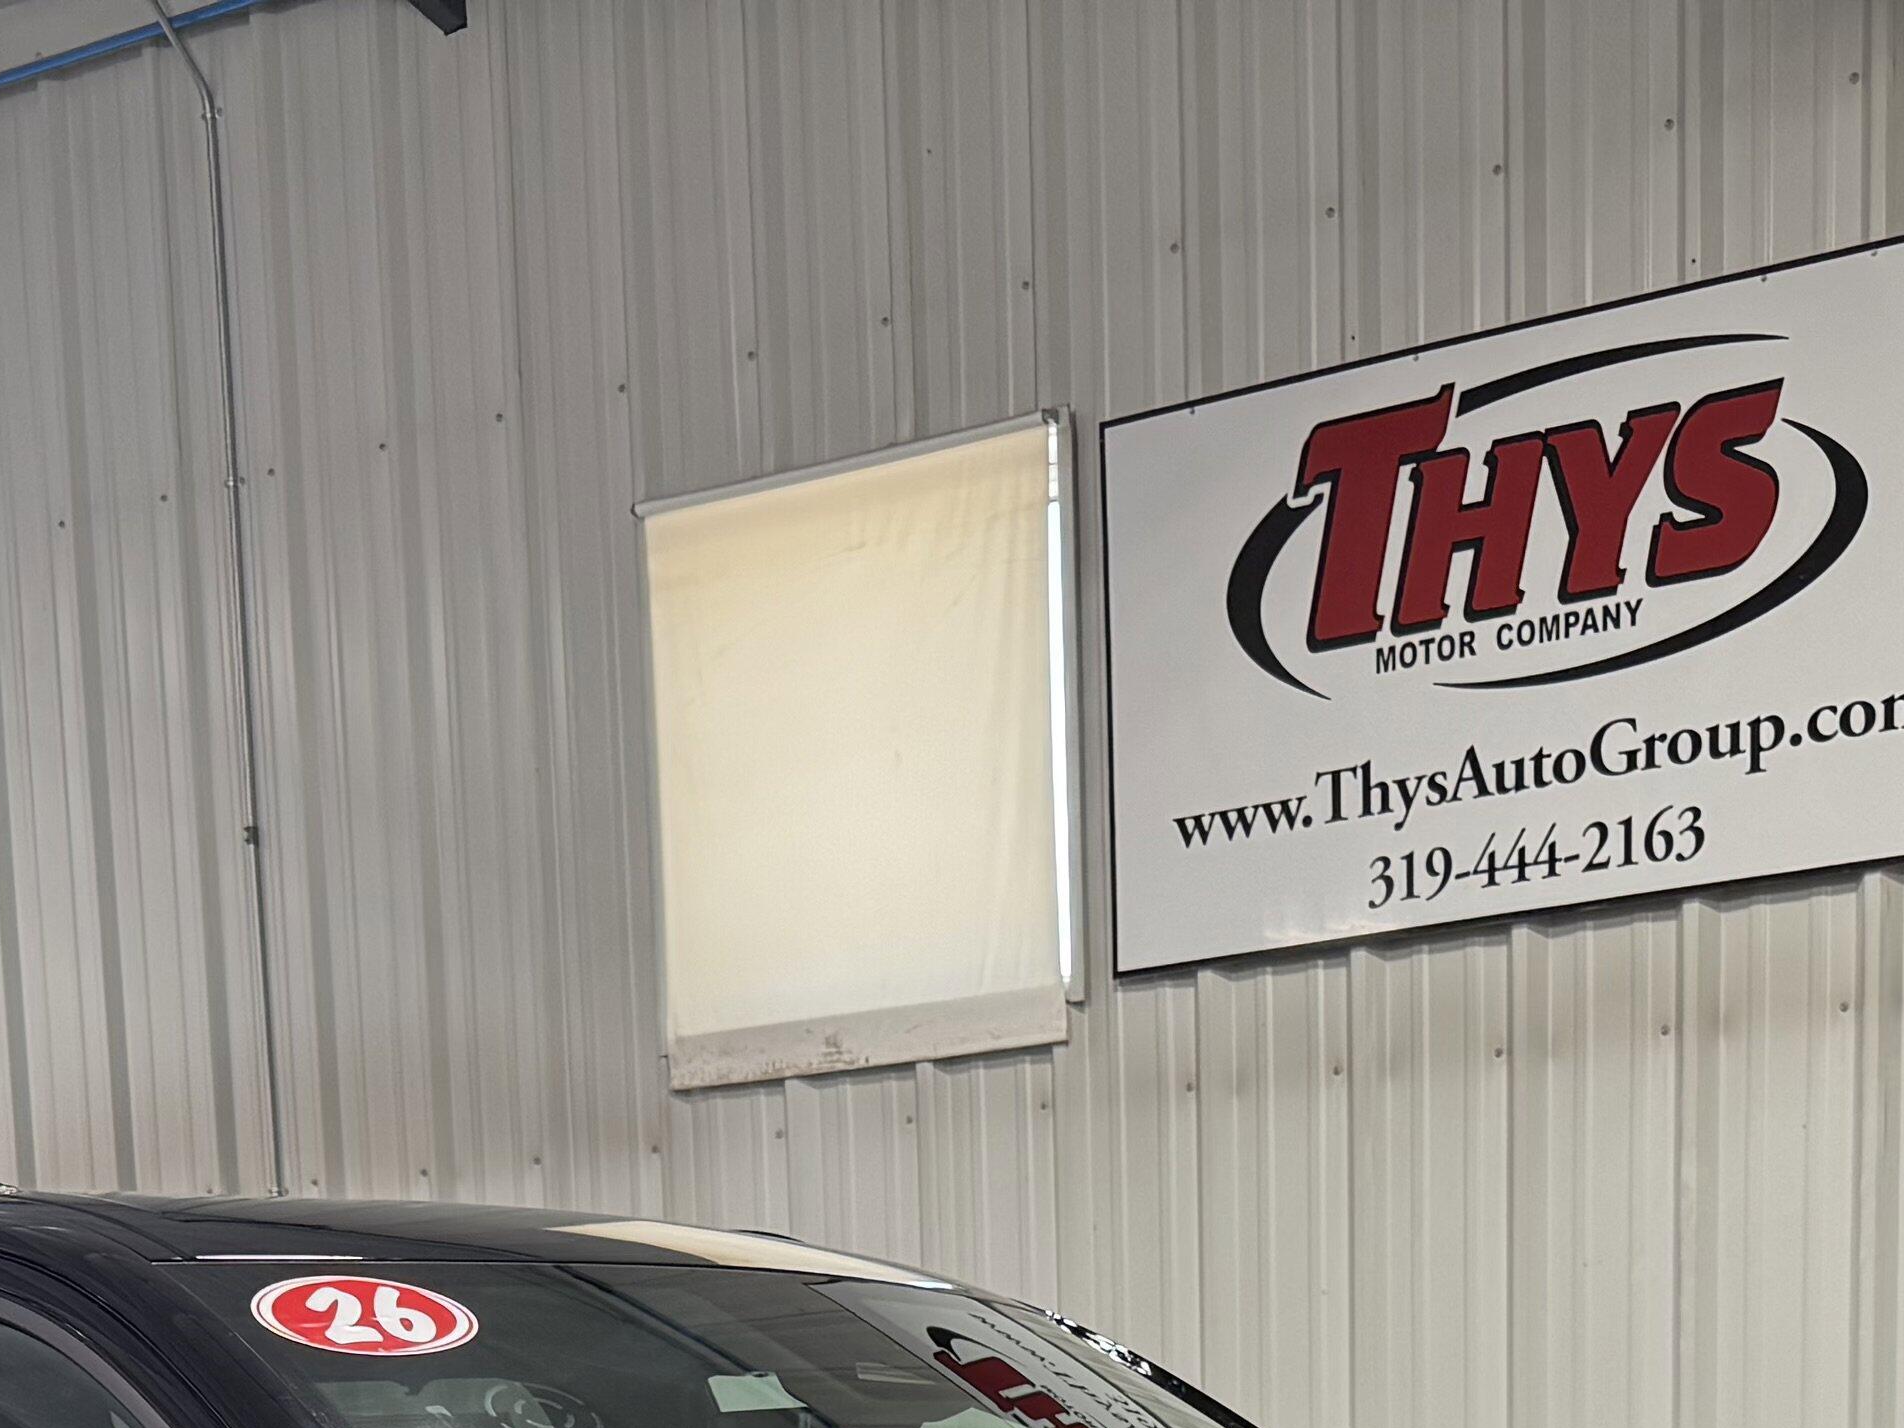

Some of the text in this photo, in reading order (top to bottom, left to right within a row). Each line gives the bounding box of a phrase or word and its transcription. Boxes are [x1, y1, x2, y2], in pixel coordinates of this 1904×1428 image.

[1292, 377, 1785, 653] THYS
[1374, 598, 1644, 674] MOTOR COMPANY
[1366, 805, 1707, 910] 319-444-2163
[304, 1285, 437, 1345] 26
